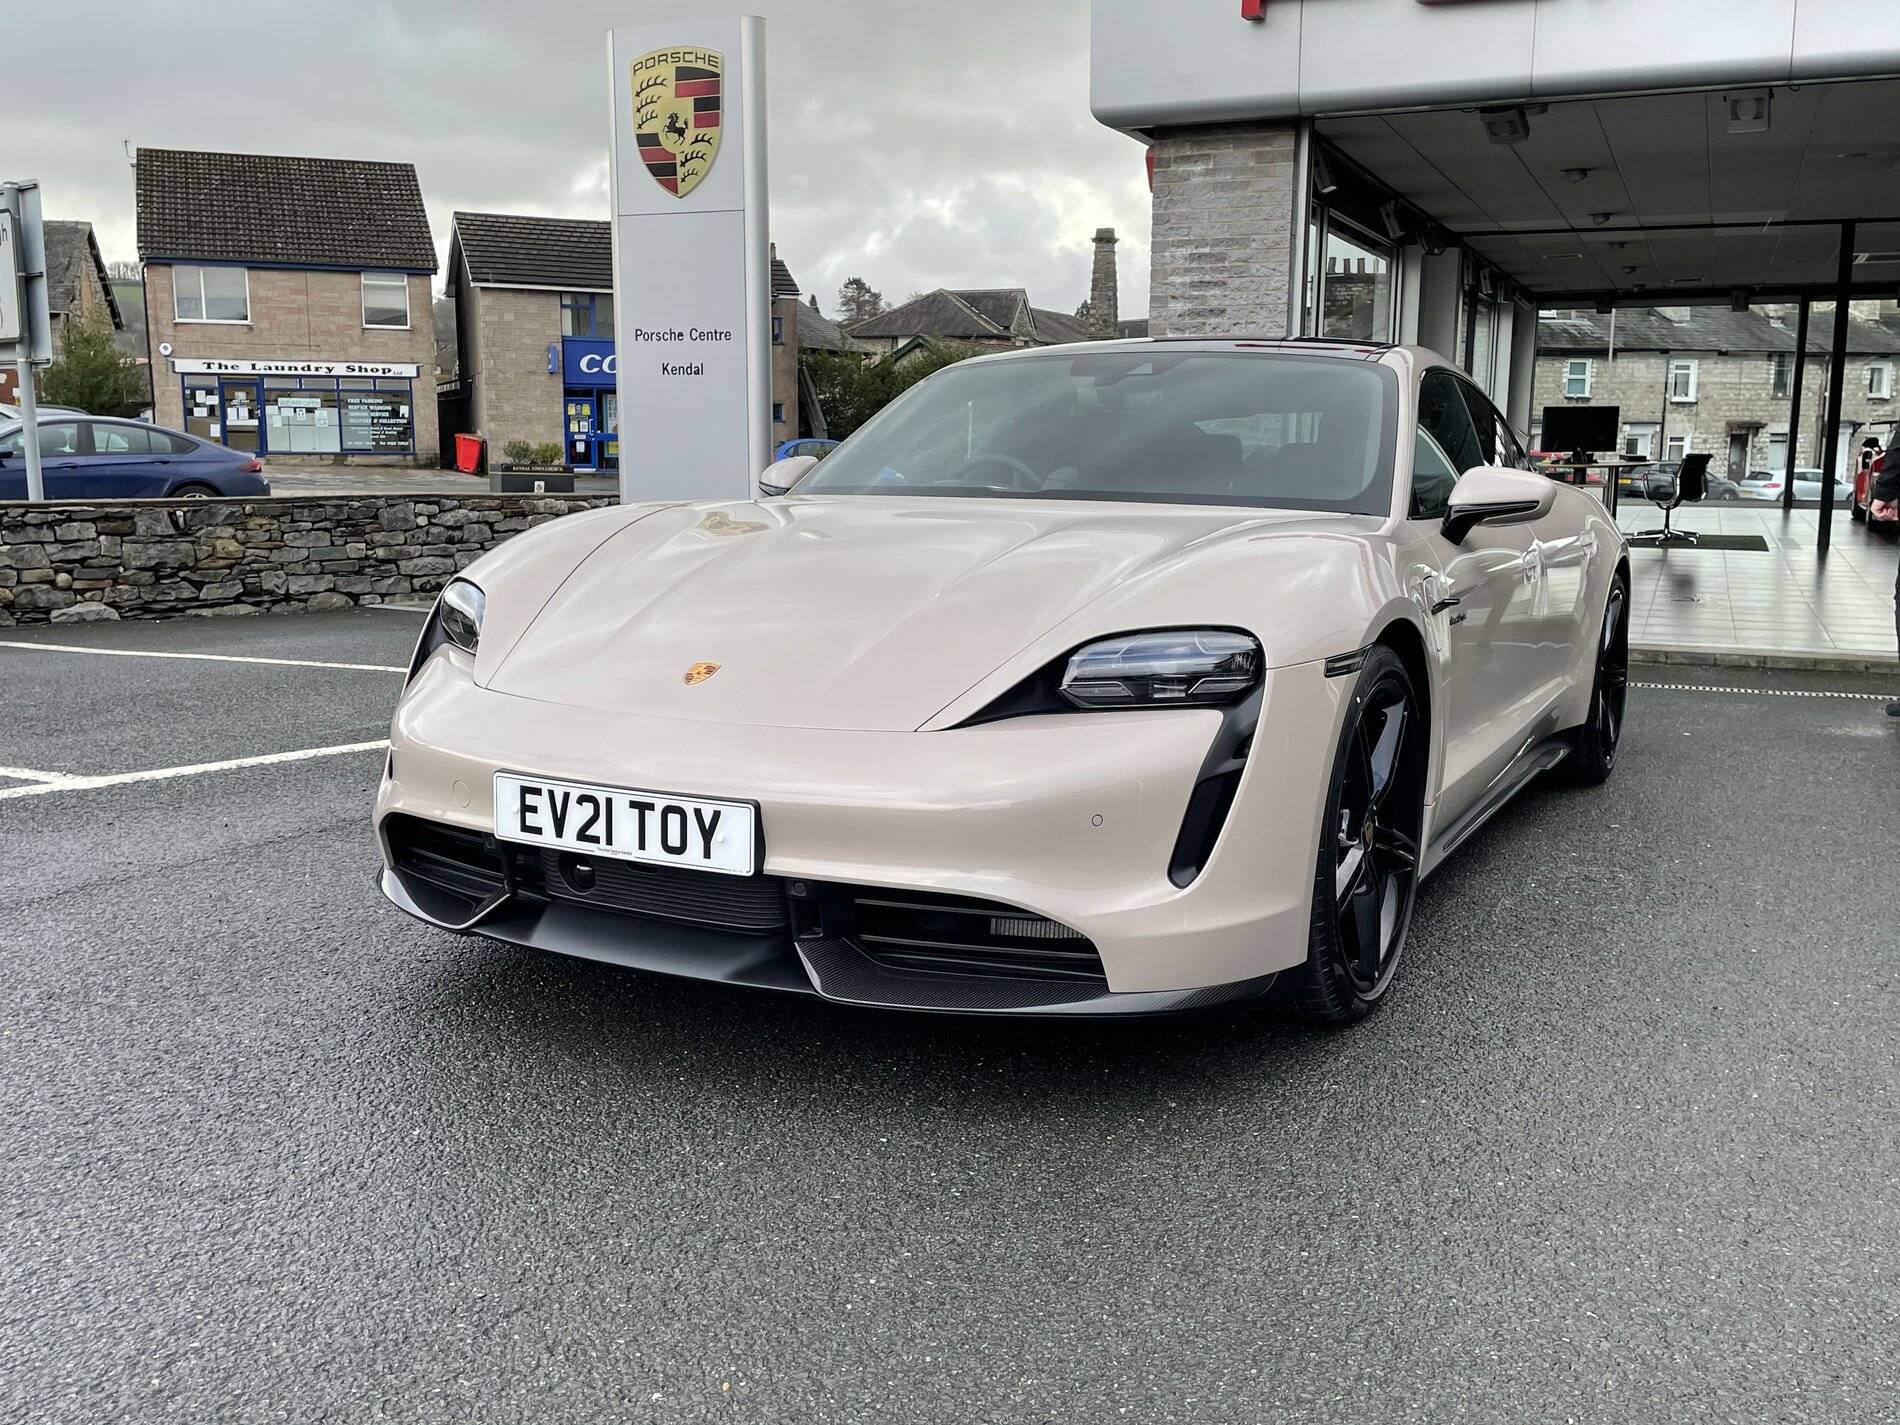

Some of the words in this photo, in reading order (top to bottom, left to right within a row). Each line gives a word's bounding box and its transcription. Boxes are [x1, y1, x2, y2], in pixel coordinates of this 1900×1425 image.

[633, 51, 719, 75] PORSCHE
[634, 328, 684, 341] Porsche
[689, 328, 732, 341] Centre
[202, 361, 240, 370] The
[250, 362, 335, 374] Laundry
[345, 364, 392, 375] Shop
[662, 362, 704, 376] Kendal
[519, 785, 614, 847] EV21
[628, 800, 722, 860] TOY
